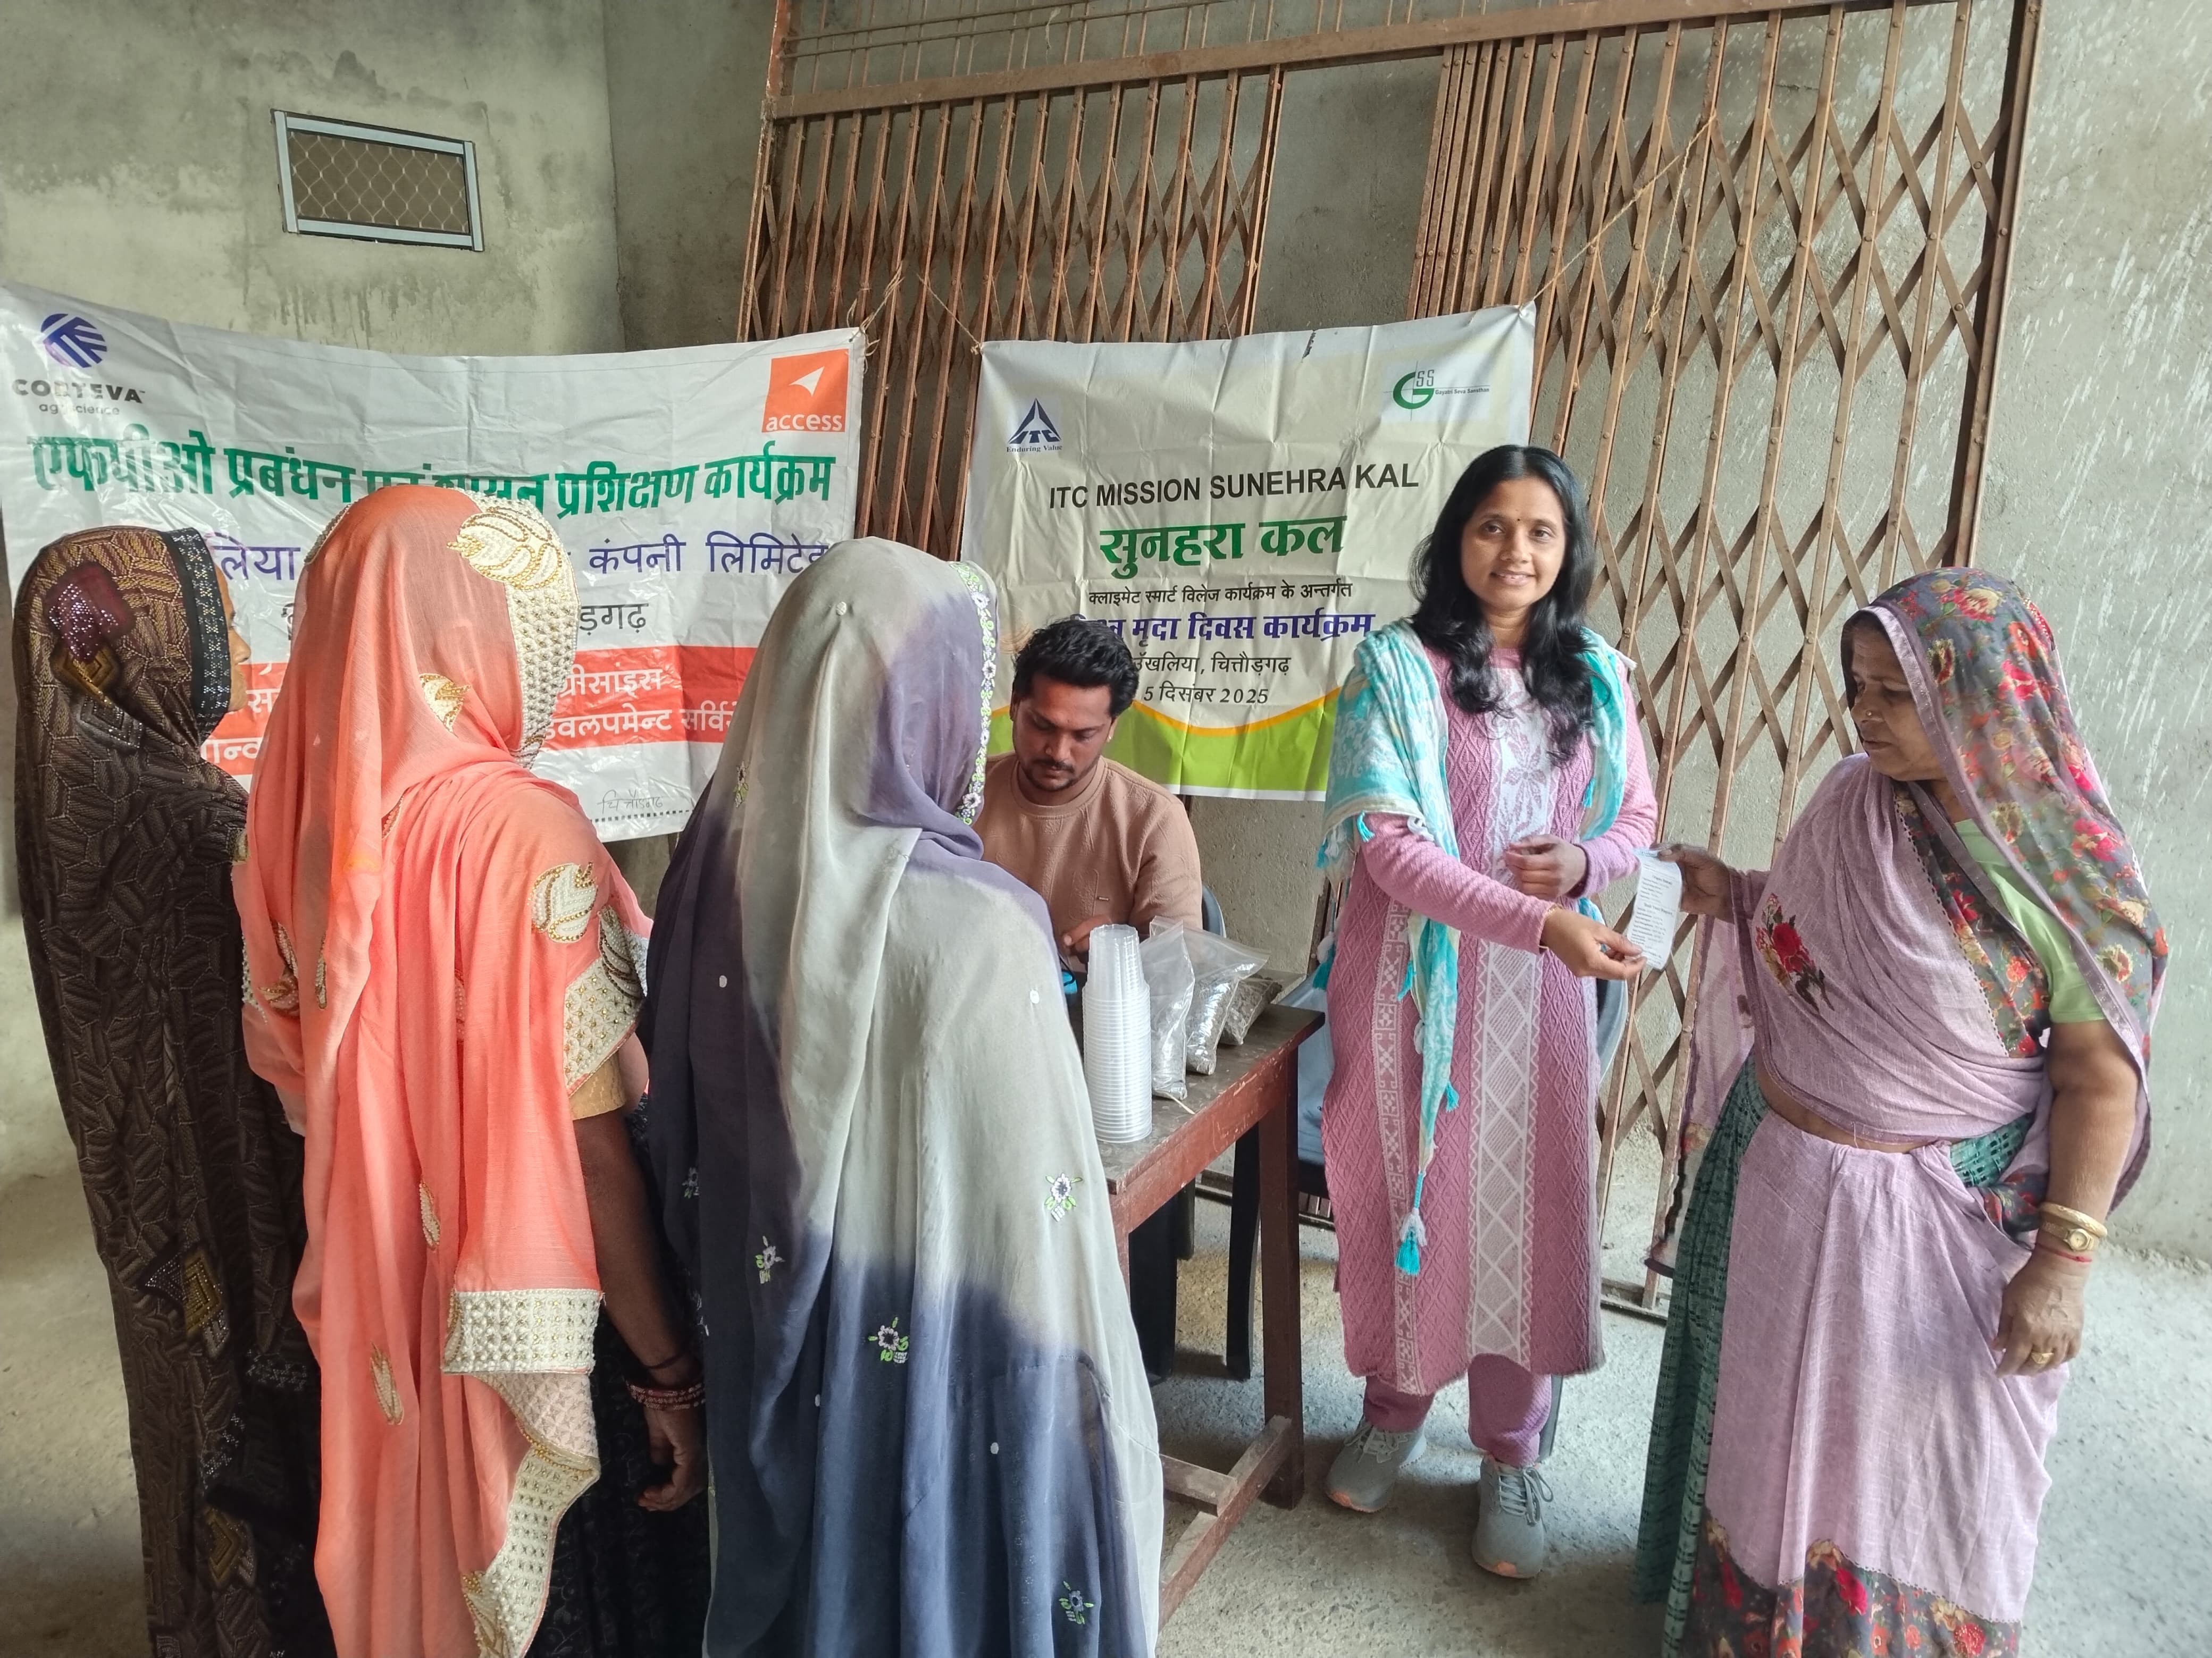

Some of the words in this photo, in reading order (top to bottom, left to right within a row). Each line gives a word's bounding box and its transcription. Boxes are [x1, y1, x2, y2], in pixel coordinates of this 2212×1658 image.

[39, 403, 120, 415] agcience
[766, 414, 843, 432] access
[224, 447, 356, 503] प्रबंधन
[555, 460, 700, 519] प्रशिक्षण
[704, 441, 836, 505] कार्यक्रम
[1049, 486, 1089, 509] ITC
[1096, 477, 1201, 507] MISSION
[1210, 467, 1347, 500] SUNEHRA
[1355, 463, 1420, 489] KAL
[589, 533, 686, 575] कंपनी
[1099, 522, 1246, 579] सुनहरा
[1259, 515, 1348, 554] कल
[1089, 586, 1141, 607] क्लाइमेट
[1145, 585, 1178, 603] स्मार्ट
[1182, 584, 1221, 603] विलेज
[1225, 582, 1277, 601] कार्यक्रम
[1280, 579, 1295, 599] के
[1301, 578, 1353, 597] अन्तर्गत
[1132, 618, 1182, 647] मृदा
[1188, 611, 1257, 641] दिवस
[1263, 607, 1376, 642] कार्यक्रम
[1211, 651, 1291, 676] चित्तौड़गढ़
[1144, 686, 1154, 701] 5
[1159, 680, 1216, 702] दिसंबर
[1219, 688, 1269, 704] 2025
